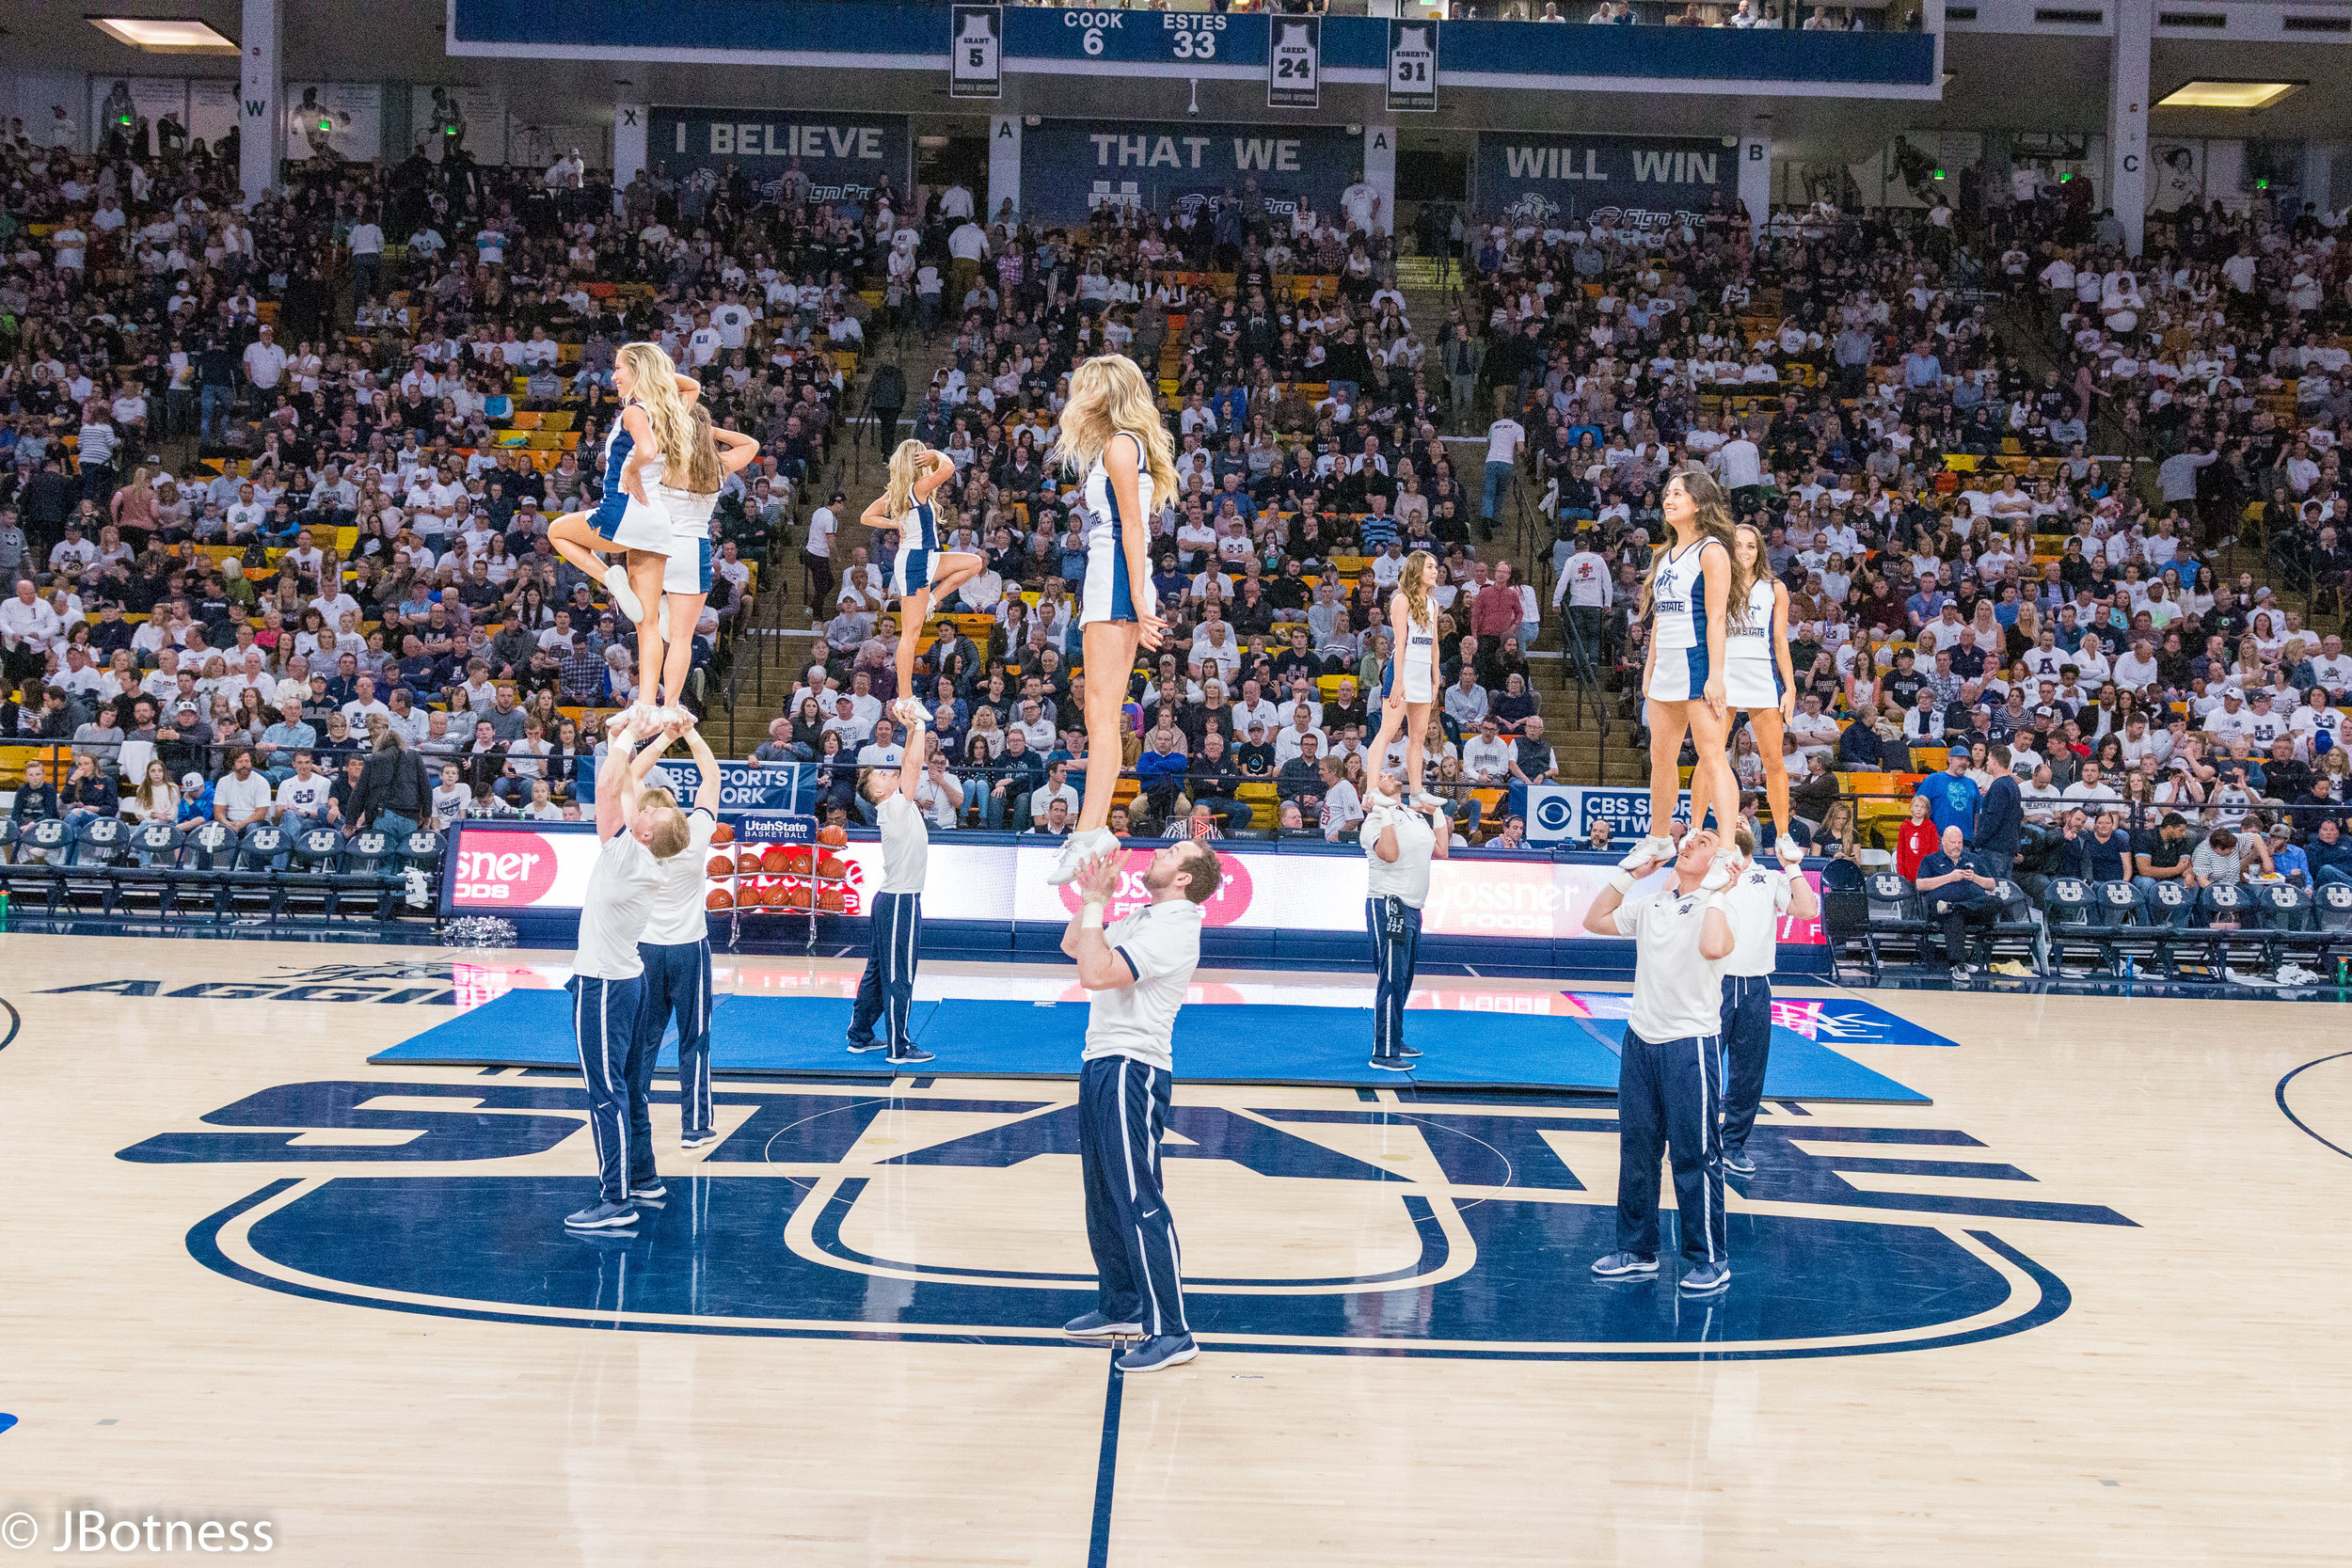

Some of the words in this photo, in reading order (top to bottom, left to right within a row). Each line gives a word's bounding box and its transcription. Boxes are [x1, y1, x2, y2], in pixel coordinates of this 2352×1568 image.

[1064, 12, 1123, 28] COOK
[1163, 14, 1227, 30] ESTES
[1083, 28, 1104, 55] 6
[1173, 31, 1216, 58] 33
[970, 48, 984, 68] 5
[1279, 58, 1311, 78] 24
[1399, 62, 1425, 81] 31
[246, 101, 265, 116] W
[624, 109, 637, 126] X
[999, 121, 1013, 138] A
[676, 122, 686, 152] I
[710, 123, 883, 159] BELIEVE
[1373, 133, 1388, 150] A
[1090, 135, 1211, 168] THAT
[1233, 138, 1301, 170] WE
[1749, 145, 1763, 161] B
[1506, 147, 1608, 181] WILL
[1632, 150, 1718, 183] WIN
[2123, 155, 2138, 172] C
[1622, 209, 1671, 230] Sign
[1661, 601, 1684, 613] STATE
[2037, 657, 2057, 674] A
[720, 769, 788, 786] PORTS
[676, 786, 766, 804] ETORK
[1586, 797, 1629, 815] CBS
[745, 820, 807, 832] UtahState
[1462, 913, 1554, 929] FOODS
[115, 1083, 2138, 1228] STATE
